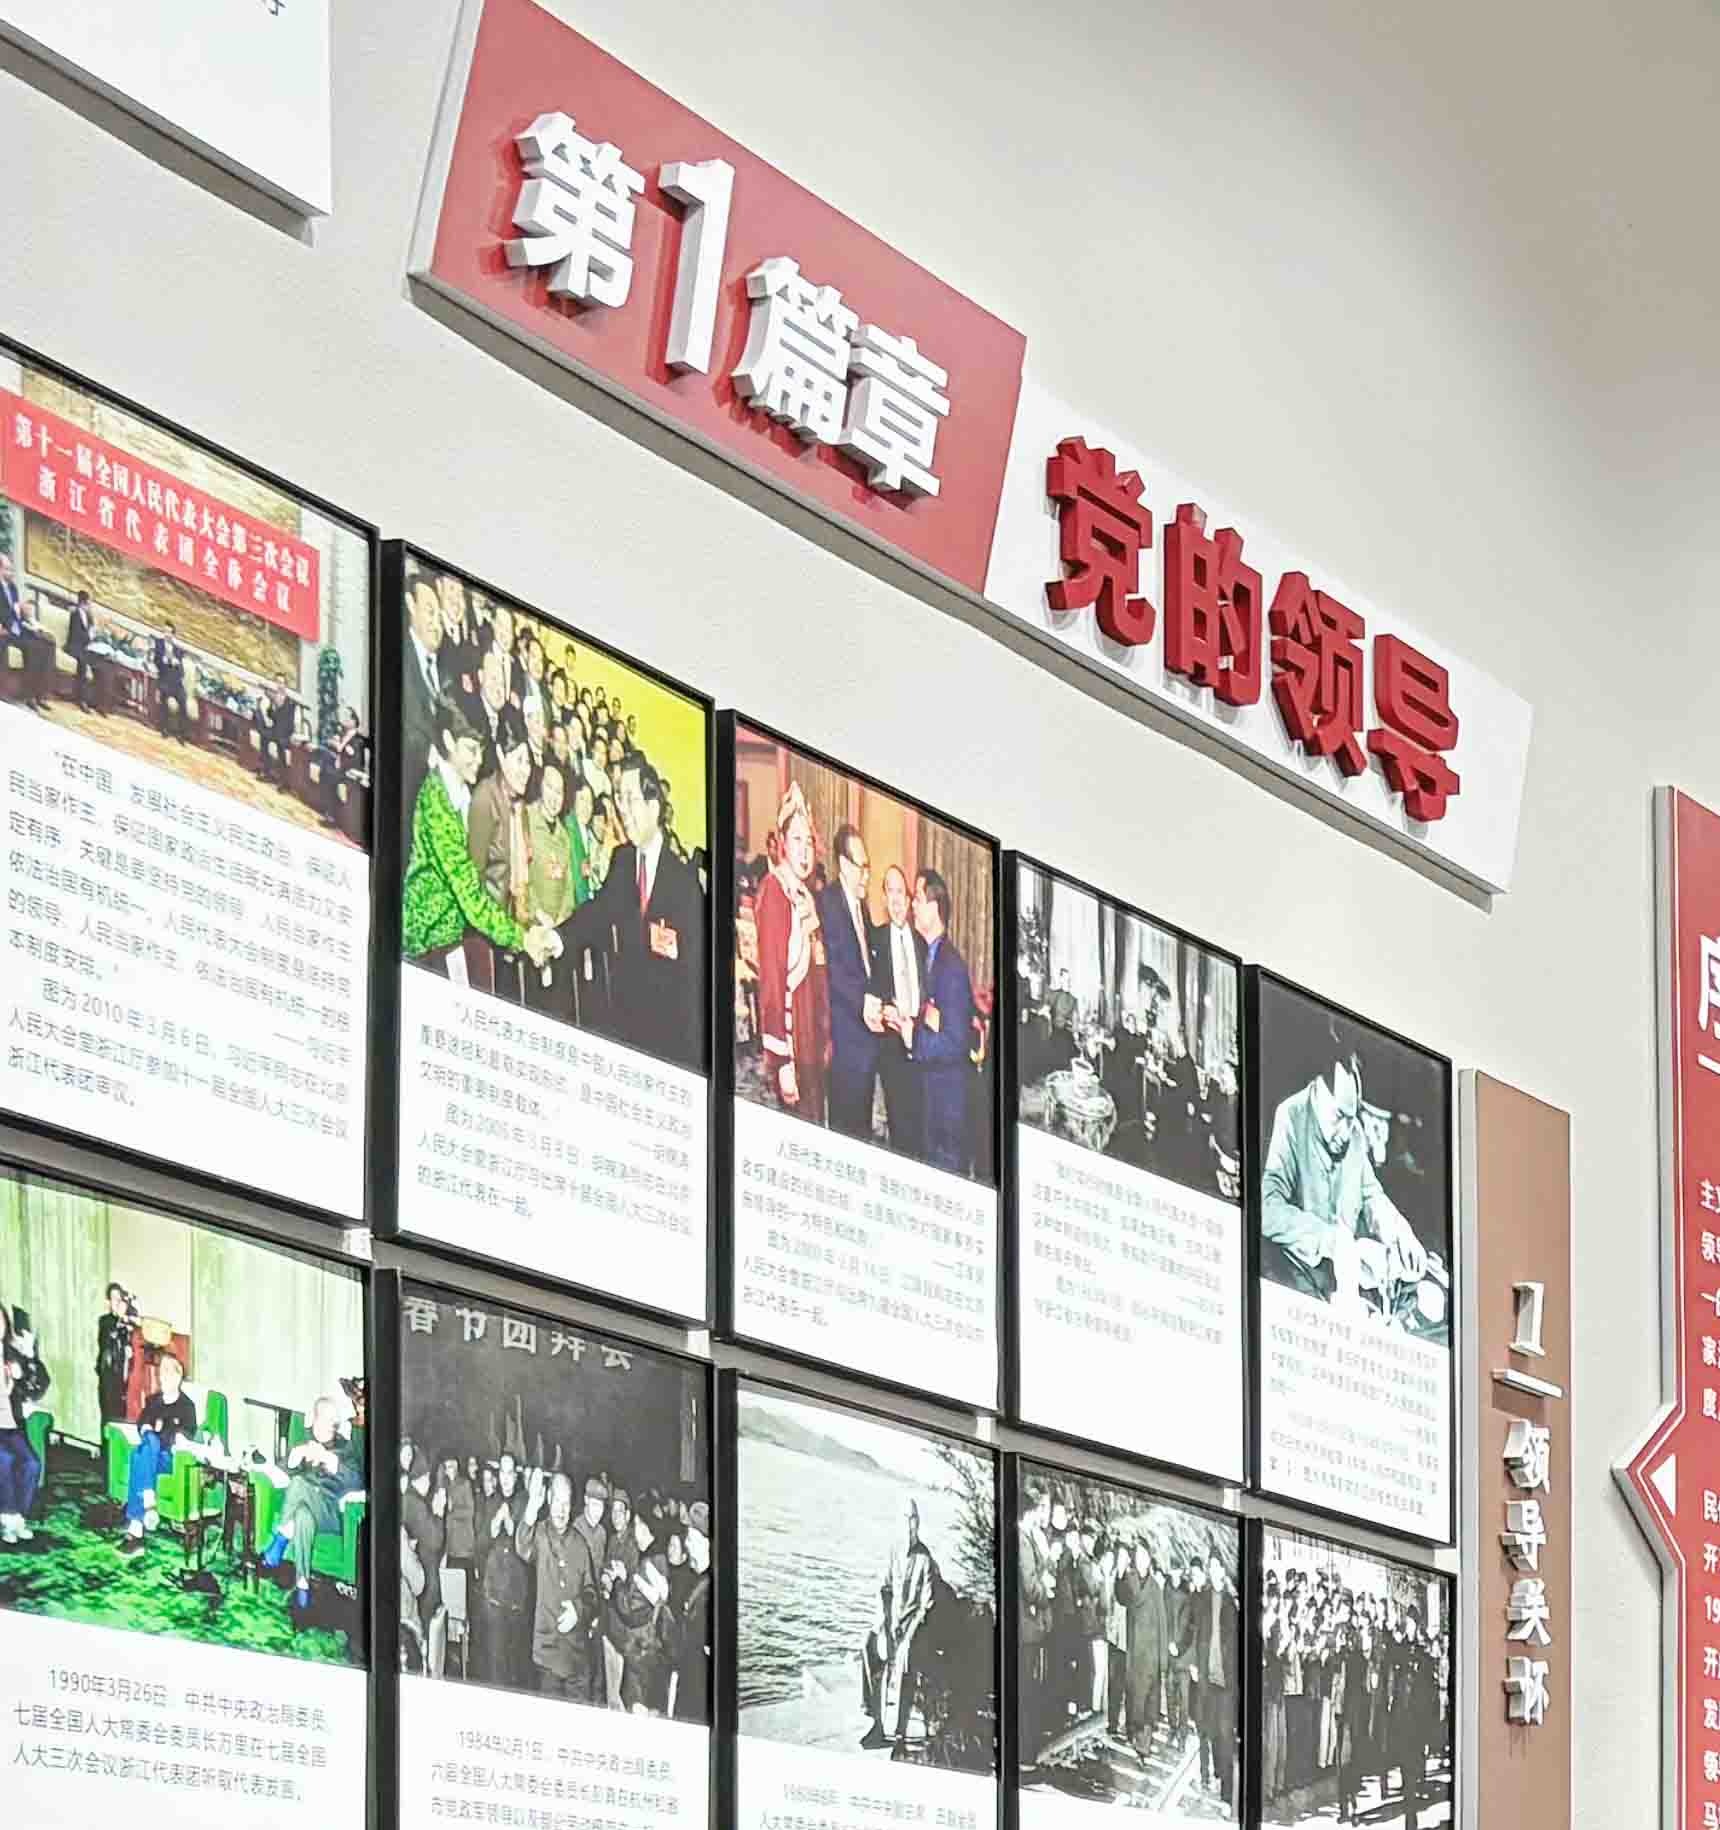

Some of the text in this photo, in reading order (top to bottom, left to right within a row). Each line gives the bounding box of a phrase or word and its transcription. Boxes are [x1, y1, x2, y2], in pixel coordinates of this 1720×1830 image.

[504, 111, 1461, 825] 第1篇章 党的领导
[1500, 1418, 1551, 1727] 领导关怀
